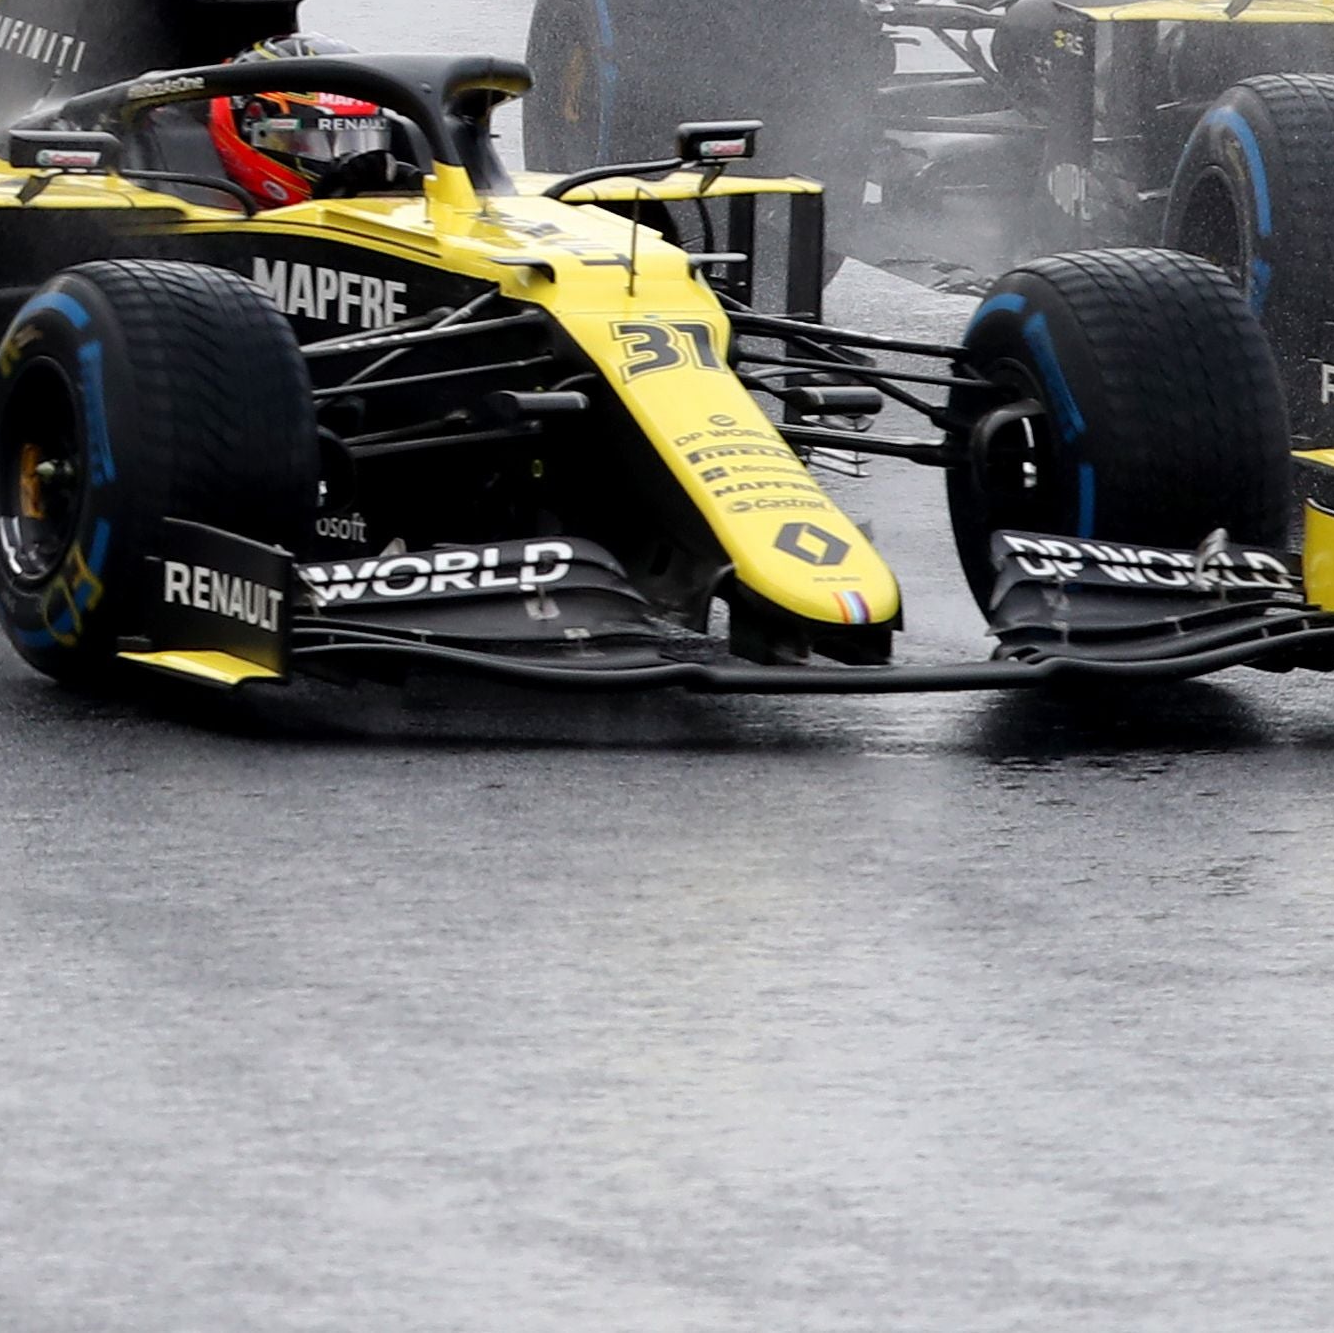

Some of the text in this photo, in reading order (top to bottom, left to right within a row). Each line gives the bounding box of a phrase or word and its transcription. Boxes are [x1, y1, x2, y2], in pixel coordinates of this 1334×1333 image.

[318, 117, 388, 131] RENAULT
[252, 257, 408, 329] MAPFRE
[608, 319, 731, 385] 31
[674, 431, 703, 447] DP
[315, 512, 367, 543] osoft
[164, 560, 284, 633] RENAULT
[298, 541, 574, 607] WORLD
